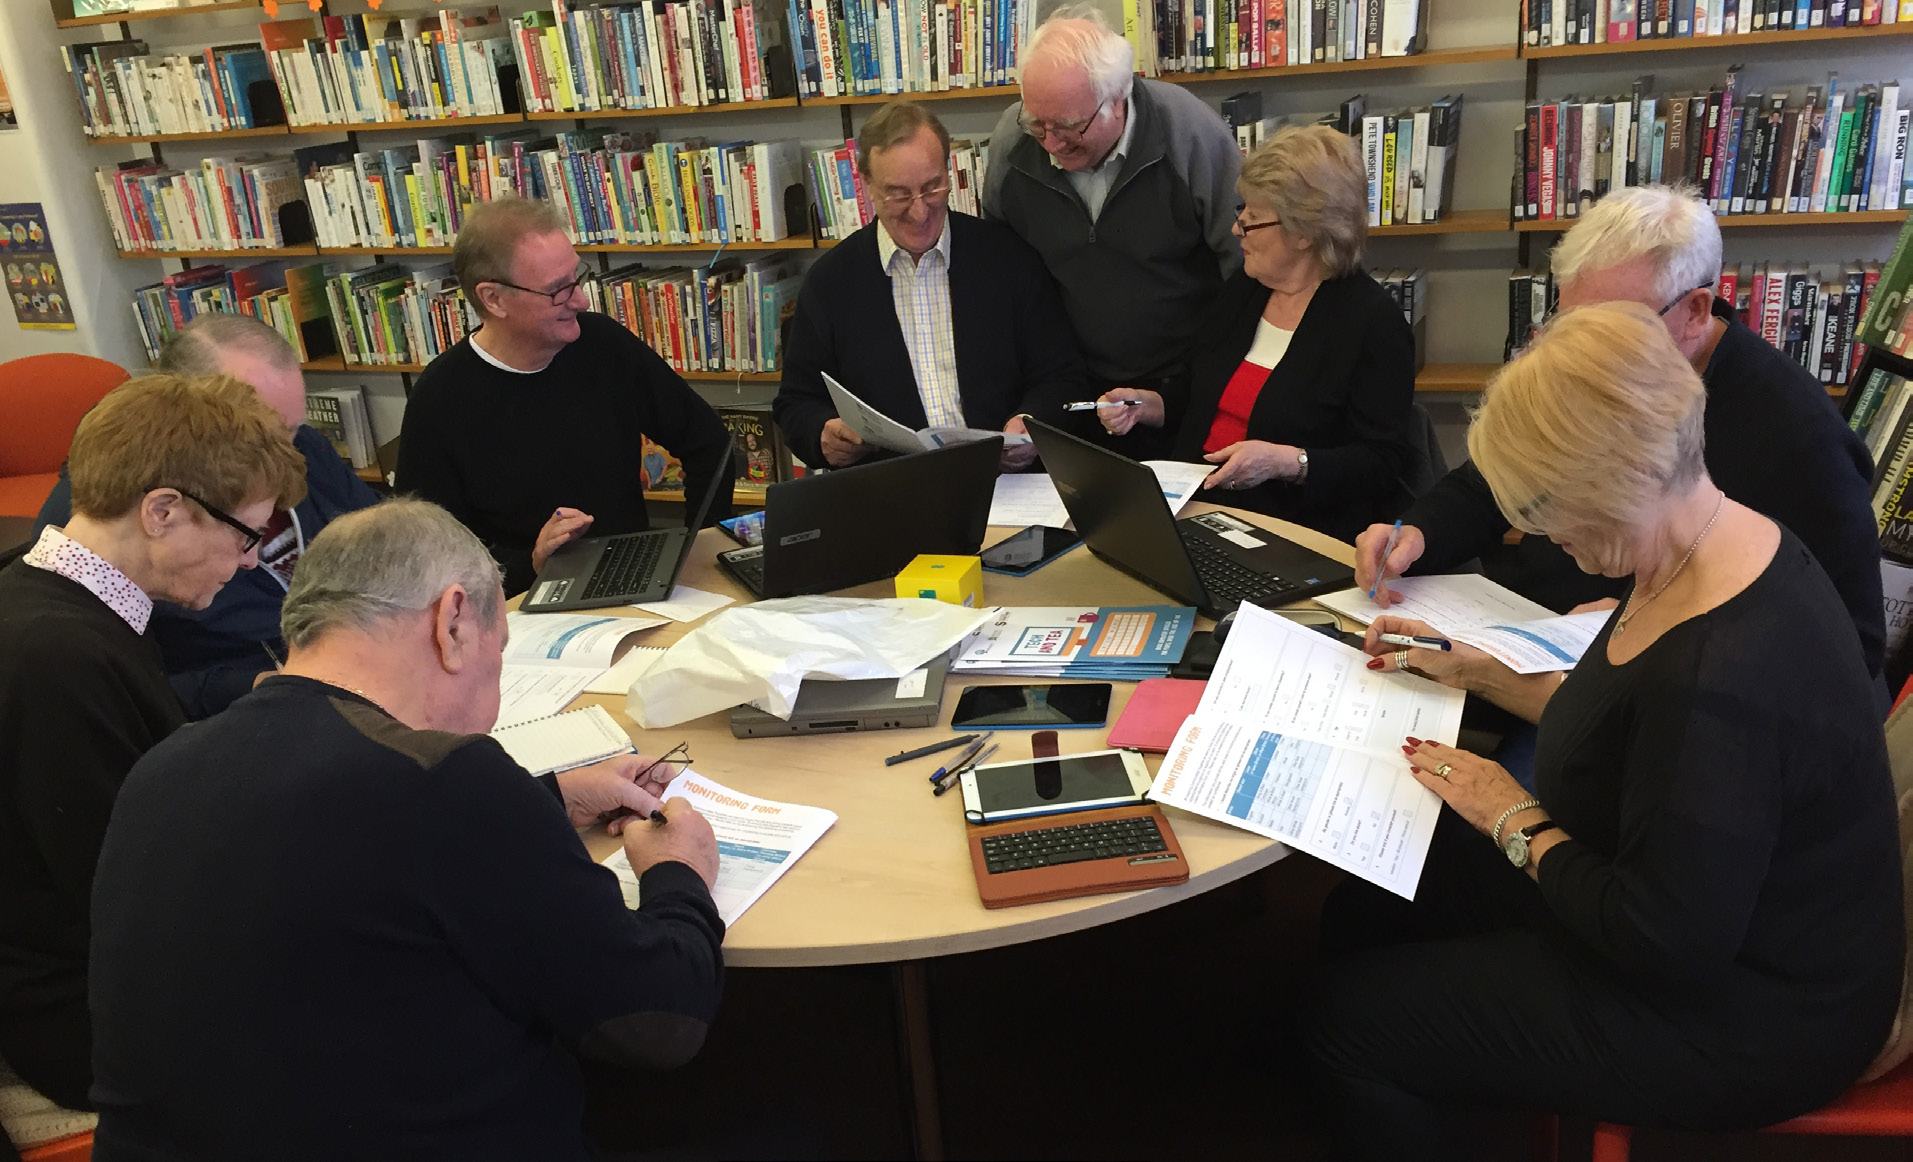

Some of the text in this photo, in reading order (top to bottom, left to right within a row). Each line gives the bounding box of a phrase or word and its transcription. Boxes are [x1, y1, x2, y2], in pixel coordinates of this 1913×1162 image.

[708, 9, 720, 51] MasterChef
[1126, 17, 1134, 32] Art
[1368, 0, 1378, 36] COHEN
[816, 9, 834, 80] you can do it
[1368, 122, 1378, 139] PETE
[1670, 102, 1684, 150] OLIVIER
[1899, 115, 1908, 134] BIG
[1367, 140, 1377, 181] TOWNSHEND
[1542, 146, 1554, 179] JOHNNY
[1895, 136, 1905, 160] RON
[1767, 278, 1783, 304] ALEX
[1792, 280, 1806, 306] Giggs
[1824, 319, 1838, 353] KEANE
[724, 422, 764, 436] AKING
[1024, 634, 1043, 649] TECH
[1038, 630, 1064, 654] AND TEA
[1161, 726, 1201, 796] MONITORING FORM
[682, 780, 782, 815] MONITORING FORM
